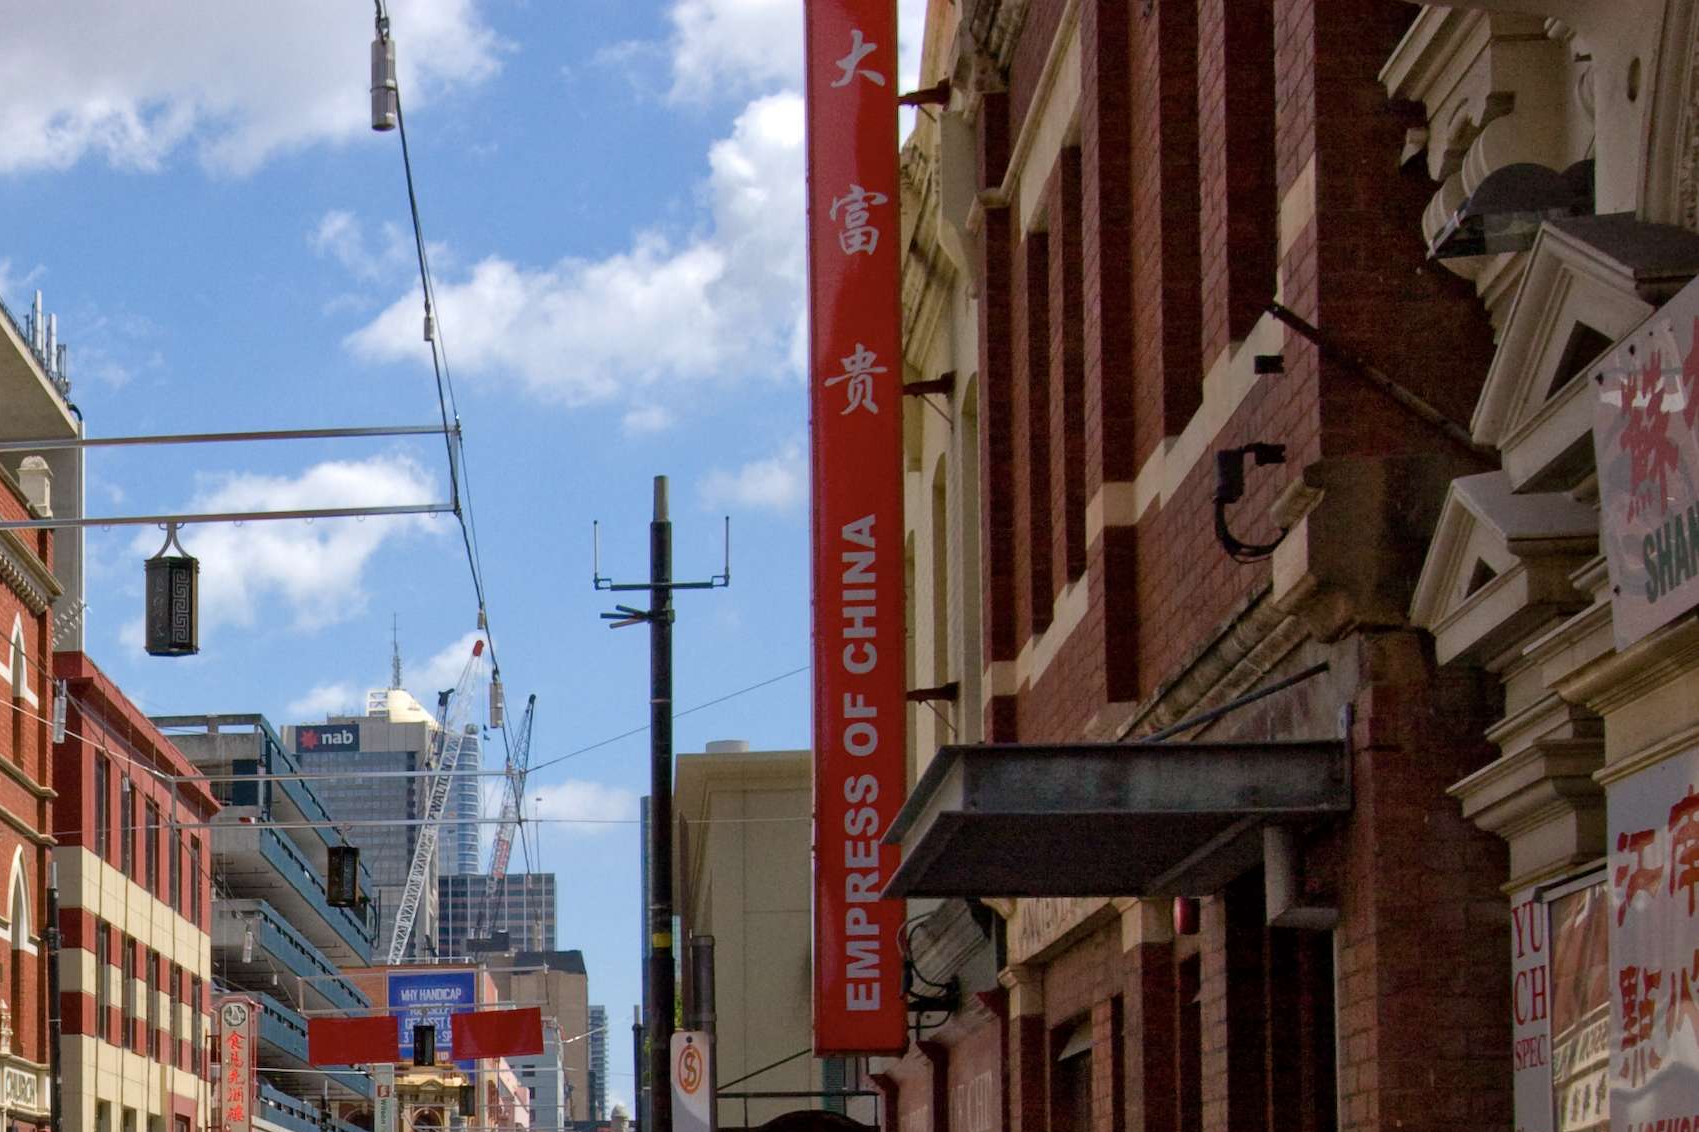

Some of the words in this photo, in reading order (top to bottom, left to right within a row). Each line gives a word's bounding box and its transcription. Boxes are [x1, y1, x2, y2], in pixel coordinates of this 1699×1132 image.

[842, 513, 878, 675] CHINA
[321, 728, 353, 745] nab
[843, 692, 879, 758] OF
[844, 775, 881, 1012] EMPRESS
[401, 989, 419, 1001] WHY
[420, 987, 461, 1000] HANDICAP
